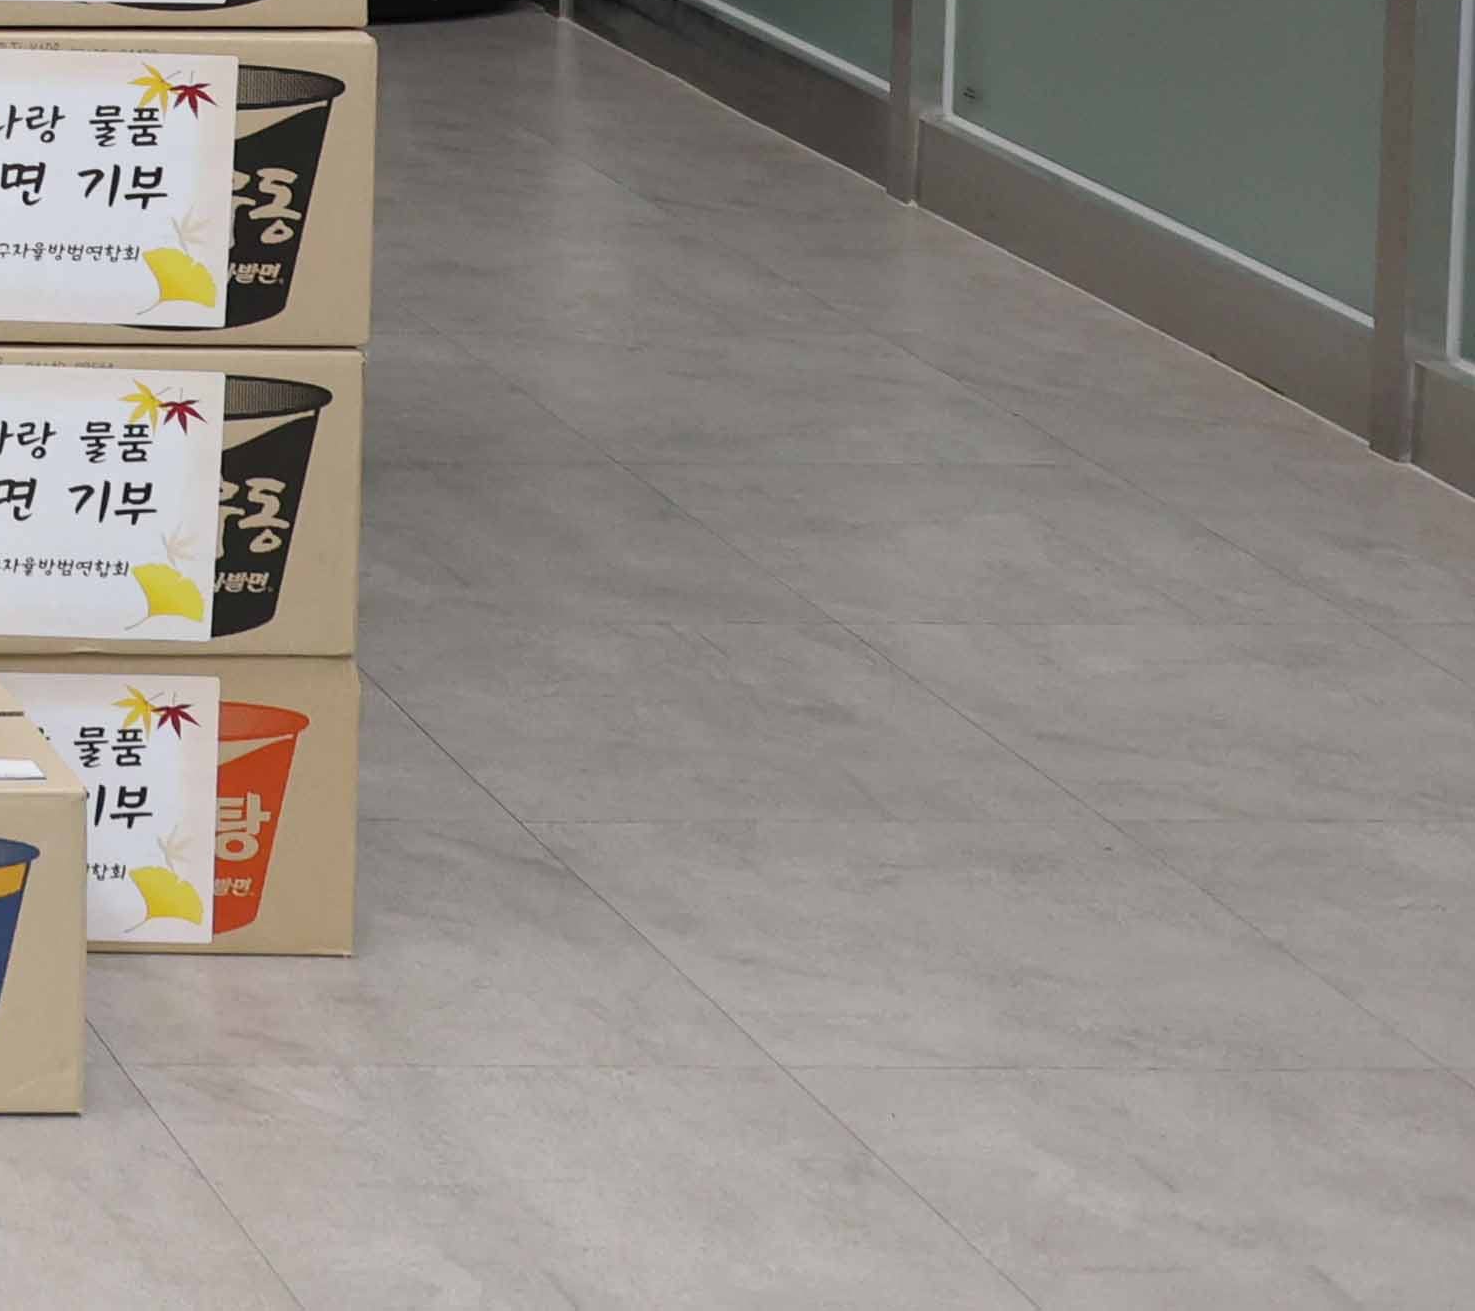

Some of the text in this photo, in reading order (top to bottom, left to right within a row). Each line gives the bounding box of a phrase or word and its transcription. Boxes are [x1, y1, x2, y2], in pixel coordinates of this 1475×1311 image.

[88, 105, 163, 148] 물품
[77, 164, 168, 210] 기부
[79, 421, 153, 464] 물품
[68, 480, 157, 526] 기부
[73, 726, 146, 769] 물품
